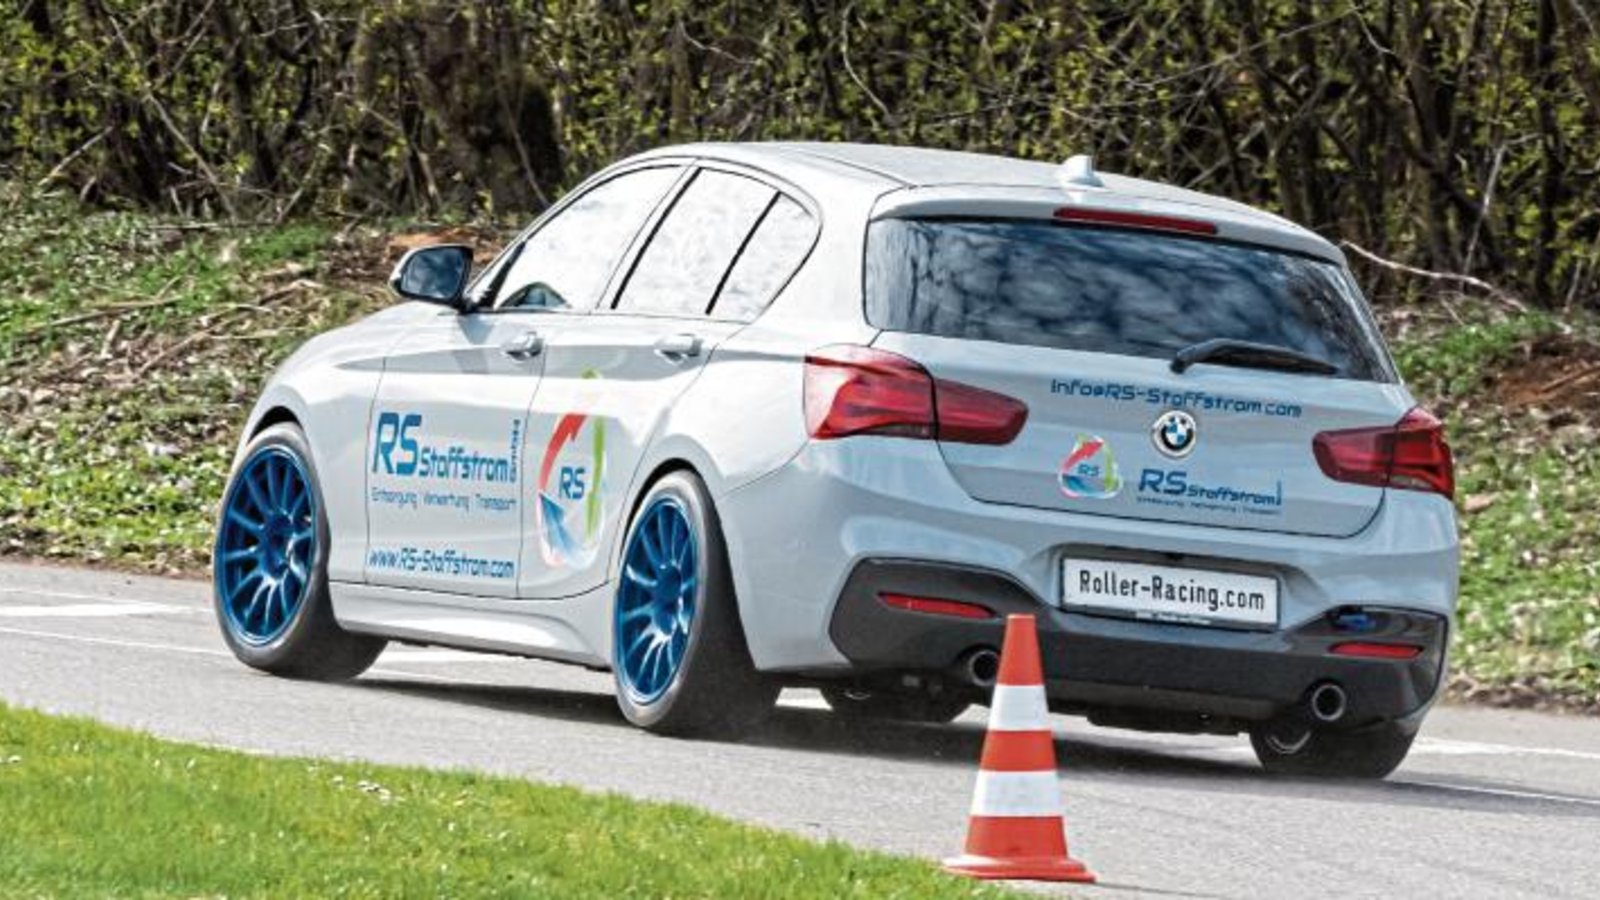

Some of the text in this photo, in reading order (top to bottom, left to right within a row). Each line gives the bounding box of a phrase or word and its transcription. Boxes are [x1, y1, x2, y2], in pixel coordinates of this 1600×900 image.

[372, 412, 421, 476] RS
[418, 447, 508, 483] Stoffstrom
[558, 467, 587, 499] RS
[1077, 464, 1101, 477] RS
[1138, 468, 1187, 495] RS
[1187, 484, 1275, 506] Stoffstrom
[1079, 570, 1265, 611] Roller-Racing.com
